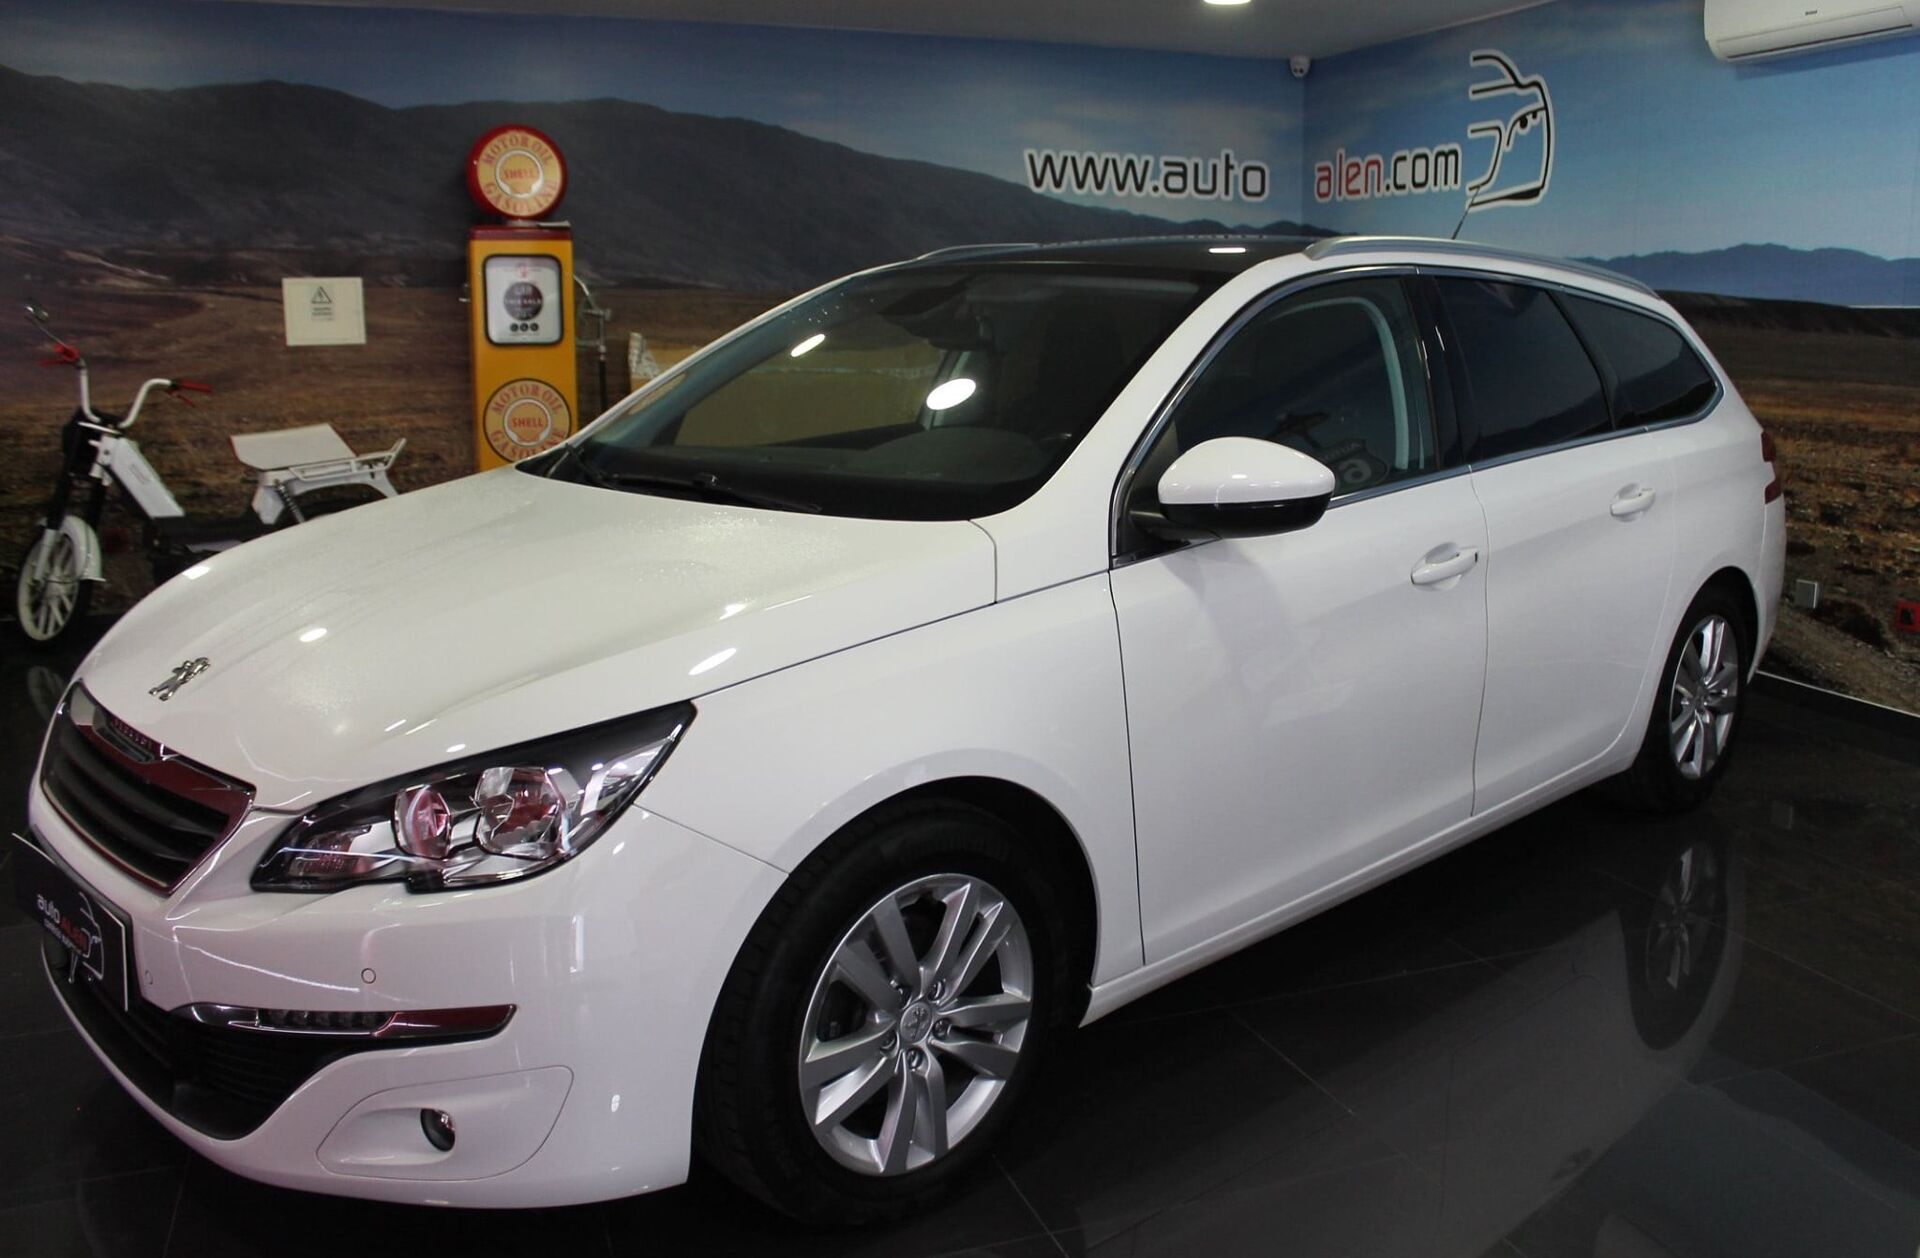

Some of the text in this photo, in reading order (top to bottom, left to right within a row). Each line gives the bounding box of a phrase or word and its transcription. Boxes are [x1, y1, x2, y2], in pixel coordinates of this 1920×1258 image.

[483, 134, 553, 166] MOTOR OIL
[503, 168, 535, 180] SHELL
[1027, 145, 1460, 199] www.auto alen.com
[484, 181, 558, 213] GASOLINE
[491, 383, 564, 415] MOTOR OIL
[511, 416, 543, 428] SHELL
